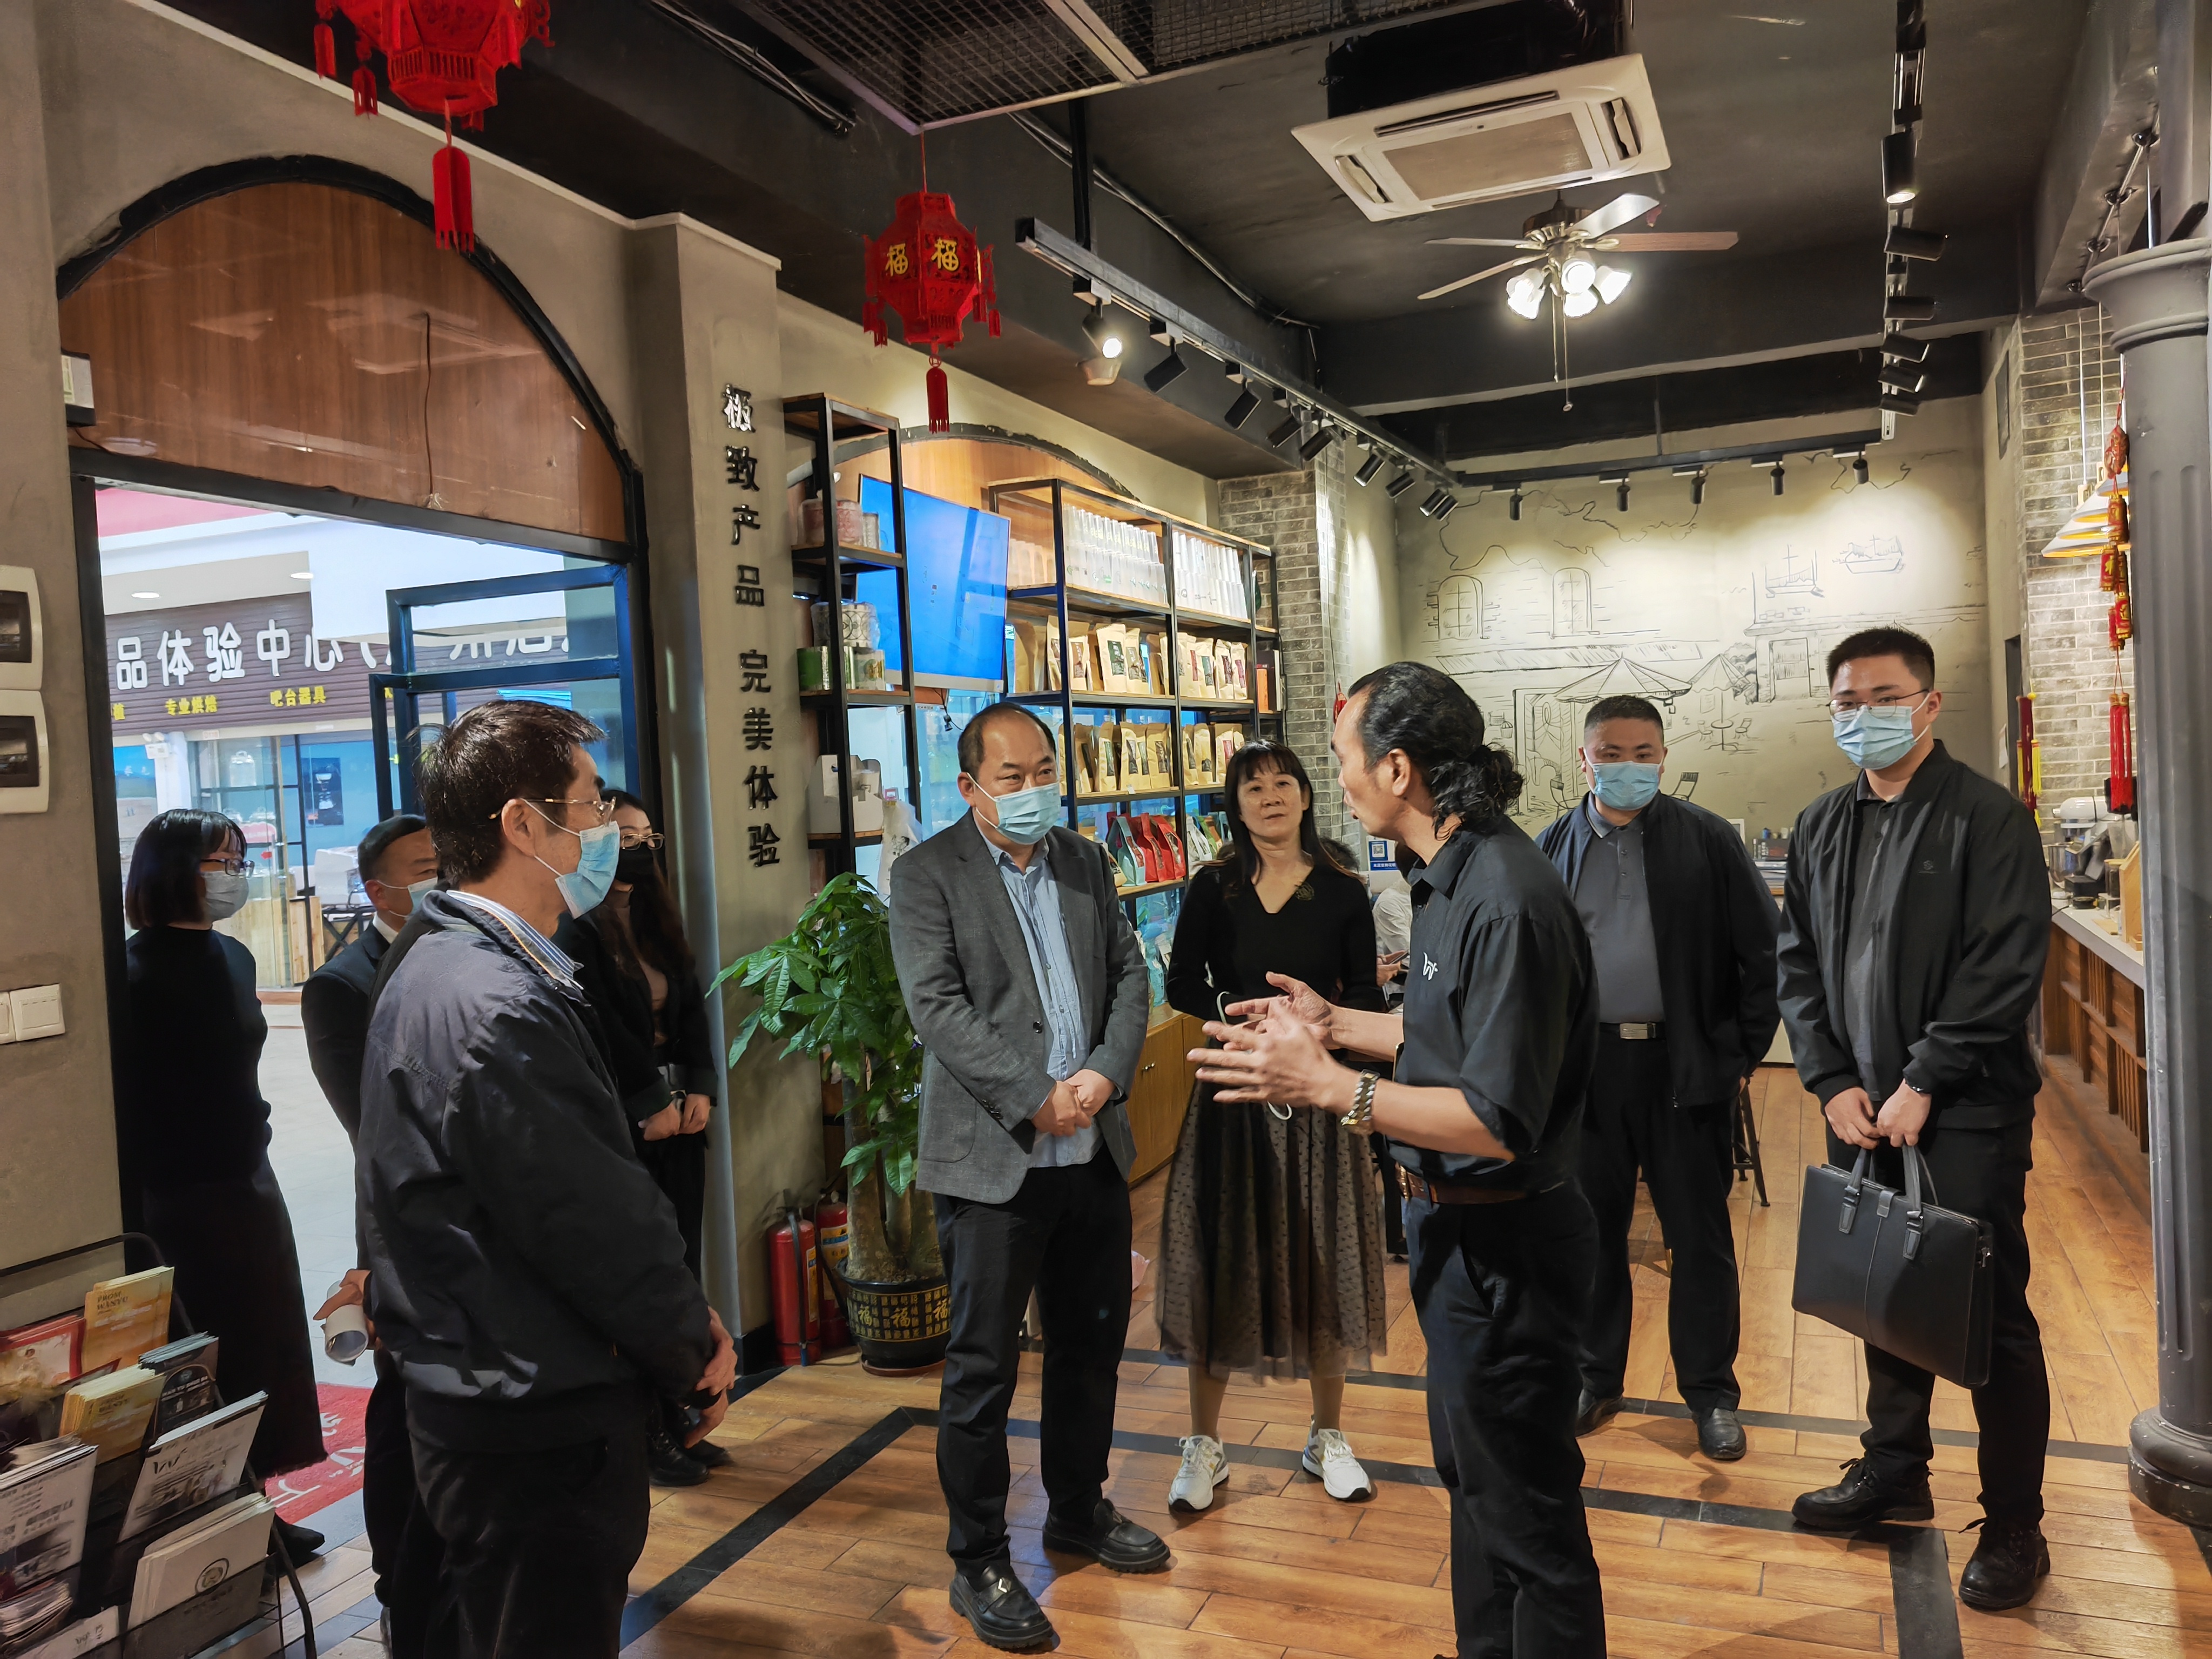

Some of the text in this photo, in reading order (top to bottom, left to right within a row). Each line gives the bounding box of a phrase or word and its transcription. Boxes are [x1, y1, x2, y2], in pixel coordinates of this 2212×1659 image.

[885, 238, 960, 277] 福 福
[721, 383, 781, 868] 极致产品 完美体验
